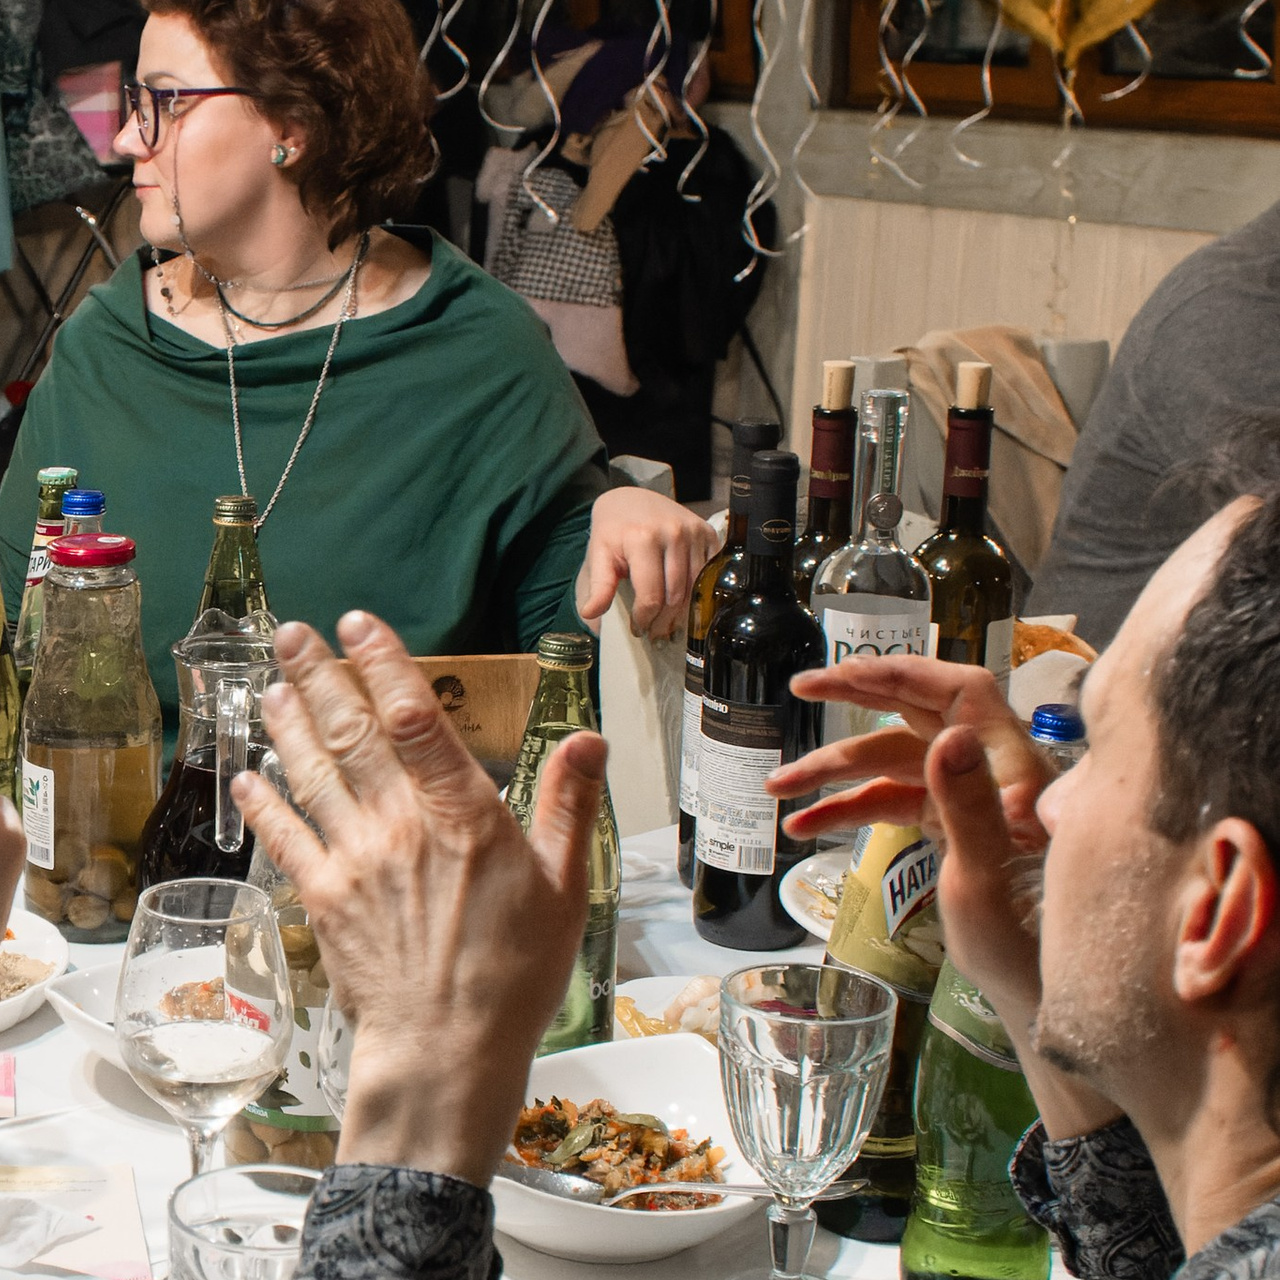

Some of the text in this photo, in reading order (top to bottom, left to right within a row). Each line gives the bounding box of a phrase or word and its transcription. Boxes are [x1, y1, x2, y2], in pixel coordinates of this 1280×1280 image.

[845, 627, 922, 640] ЧИСТЫЕ
[709, 837, 735, 852] simple
[589, 976, 614, 1001] bo
